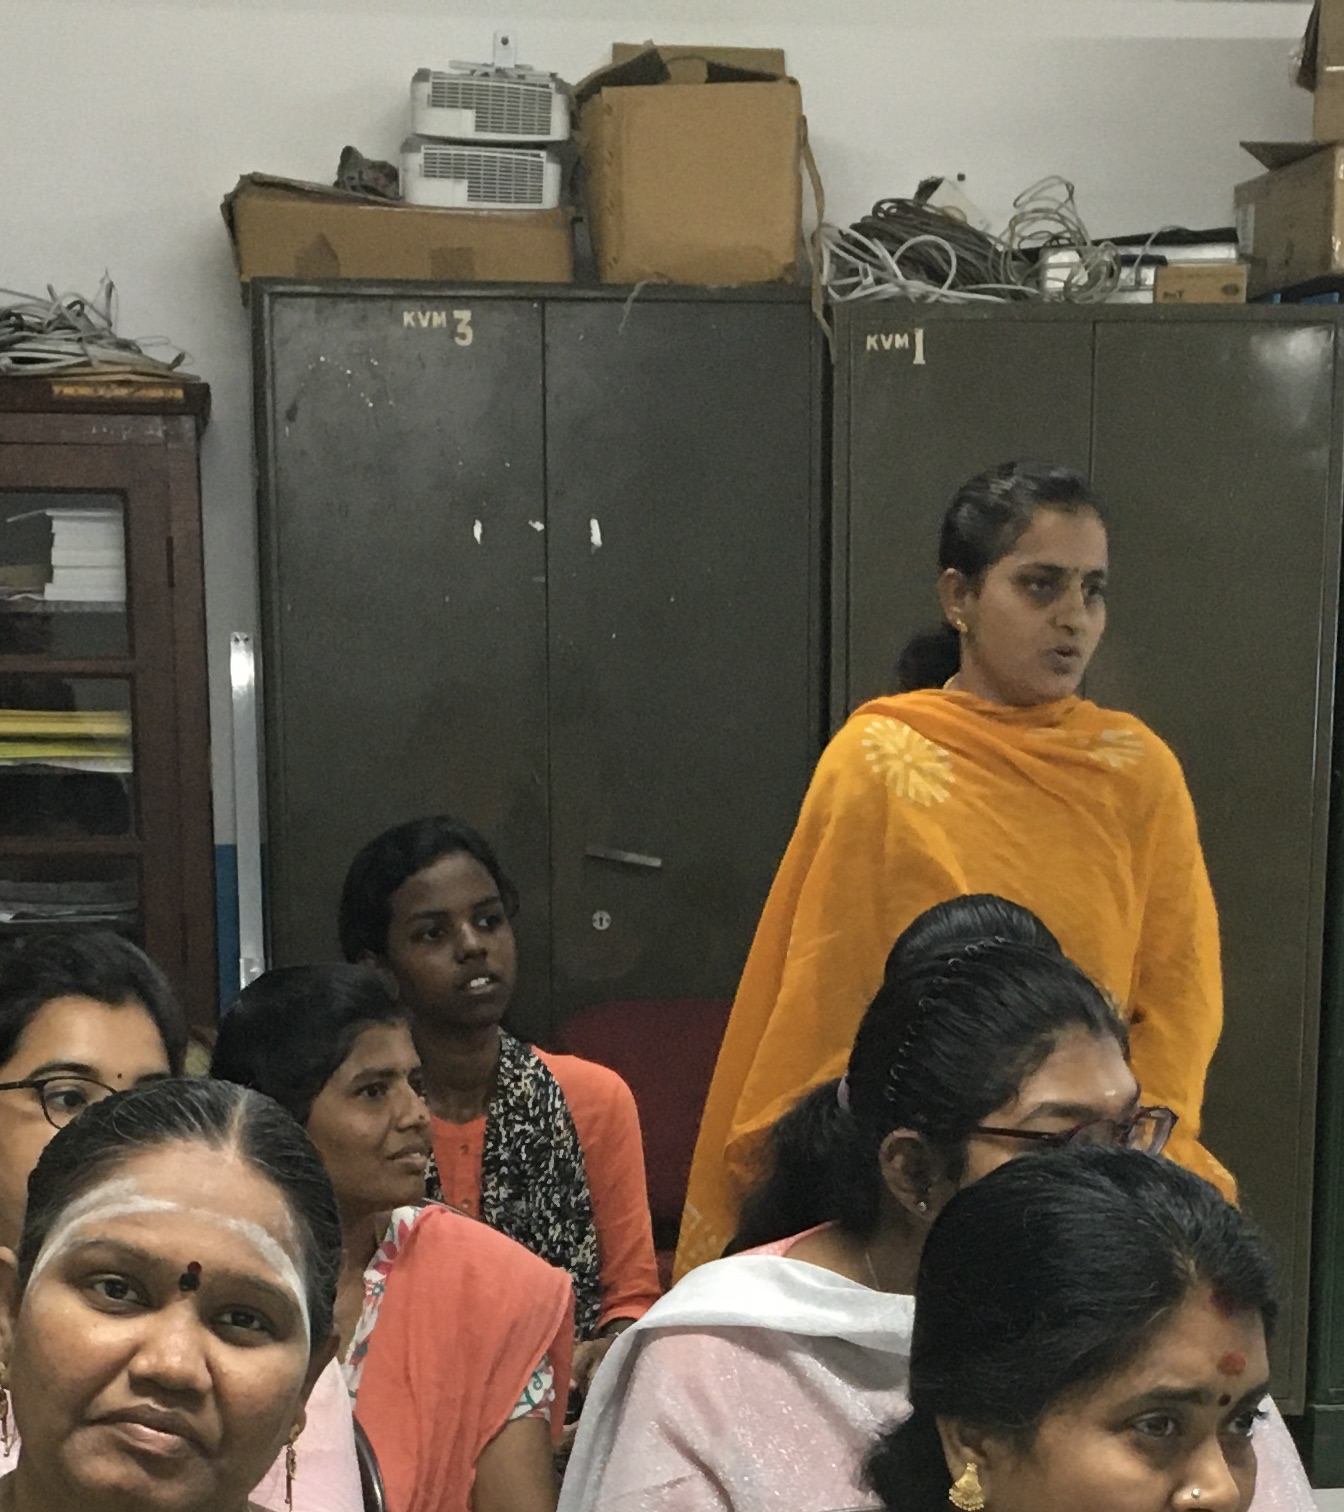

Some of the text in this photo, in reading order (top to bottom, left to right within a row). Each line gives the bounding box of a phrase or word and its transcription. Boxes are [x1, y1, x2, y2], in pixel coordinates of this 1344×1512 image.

[402, 308, 474, 347] KVM 3
[866, 327, 926, 365] KVM 1
